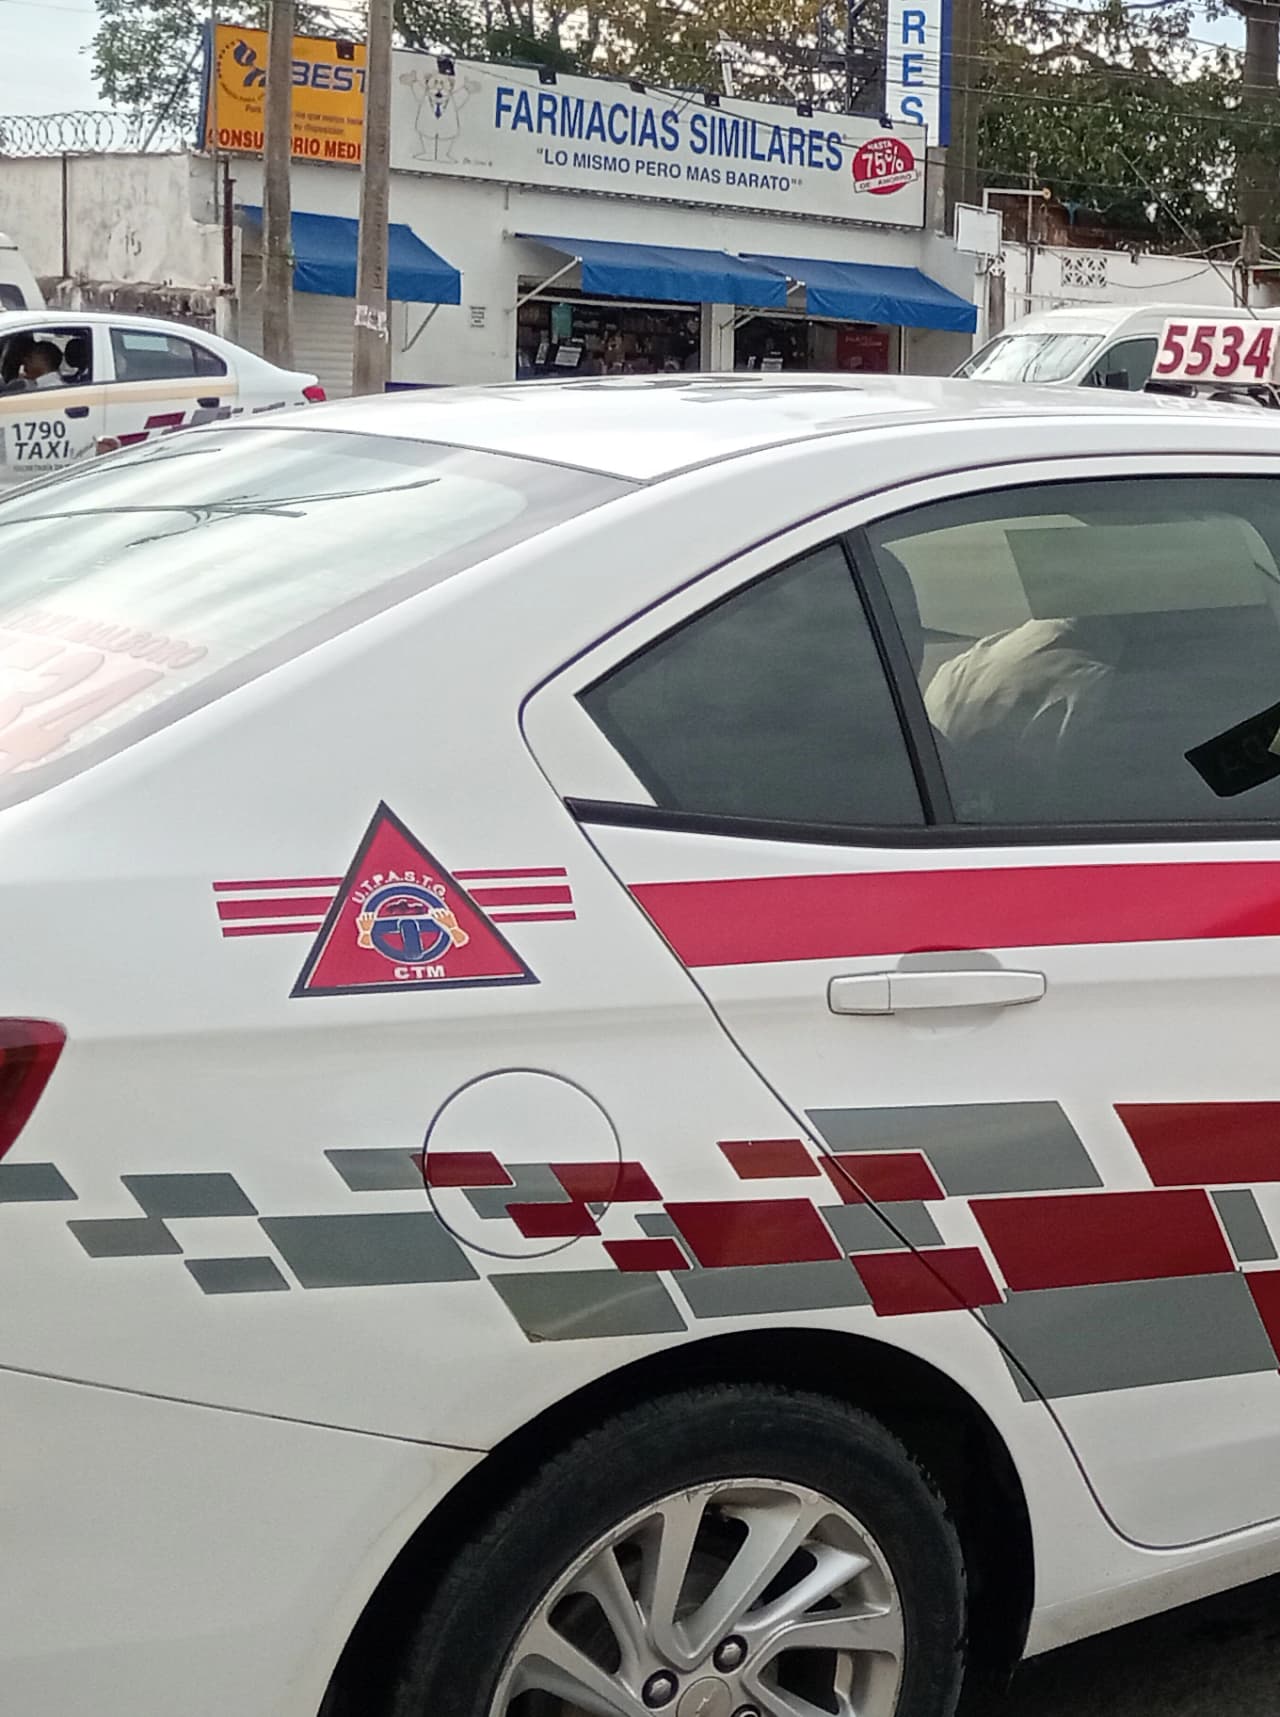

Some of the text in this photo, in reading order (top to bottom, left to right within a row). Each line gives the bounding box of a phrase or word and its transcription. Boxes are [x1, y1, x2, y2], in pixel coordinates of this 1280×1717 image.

[494, 86, 843, 171] FARMACIAS SIMILARES
[867, 140, 893, 150] HASTA
[572, 152, 631, 173] MISMO
[635, 159, 681, 180] PERO
[686, 166, 721, 184] MAS
[862, 147, 905, 178] 75%
[1156, 324, 1274, 378] 5534
[11, 420, 66, 441] 1790
[15, 440, 70, 460] TAXI
[394, 965, 445, 979] CTM
